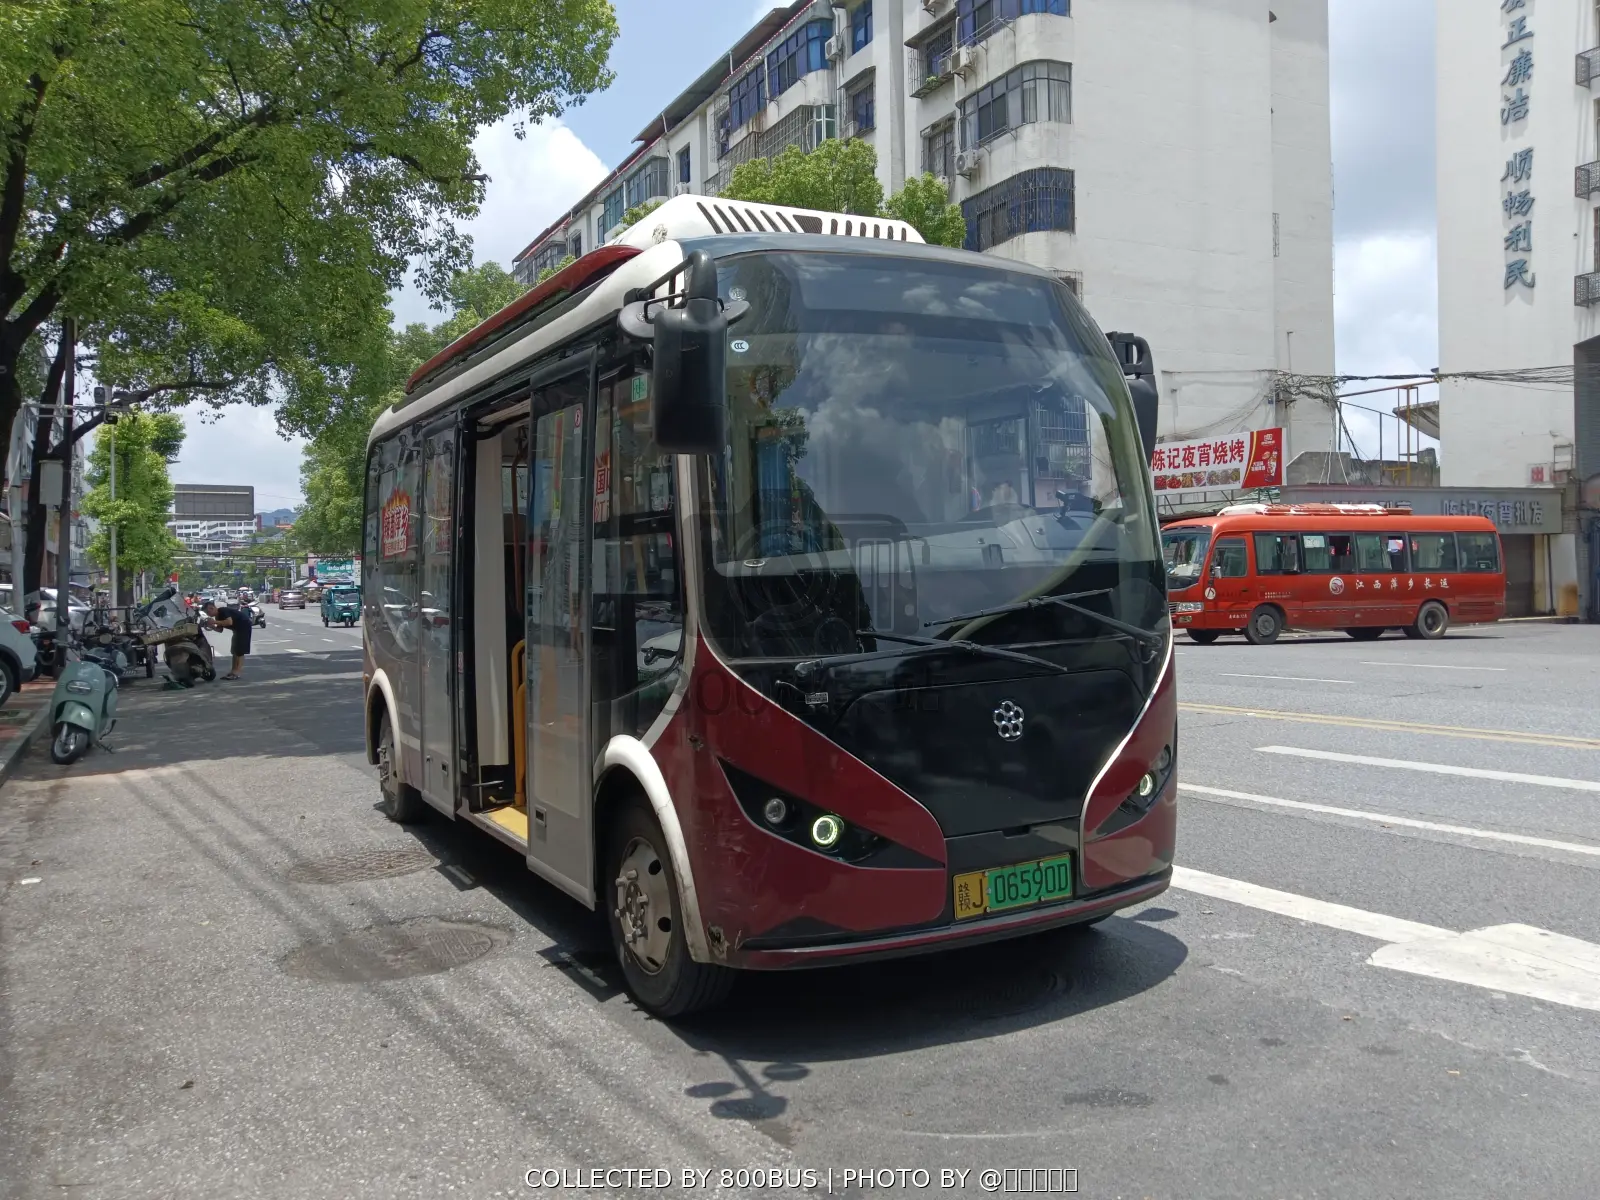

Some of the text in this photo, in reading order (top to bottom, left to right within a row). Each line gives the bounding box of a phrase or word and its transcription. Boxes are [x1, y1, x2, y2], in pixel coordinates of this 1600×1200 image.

[1500, 147, 1536, 289] 顺畅利民
[1152, 439, 1245, 472] 陈记夜宵烧烤
